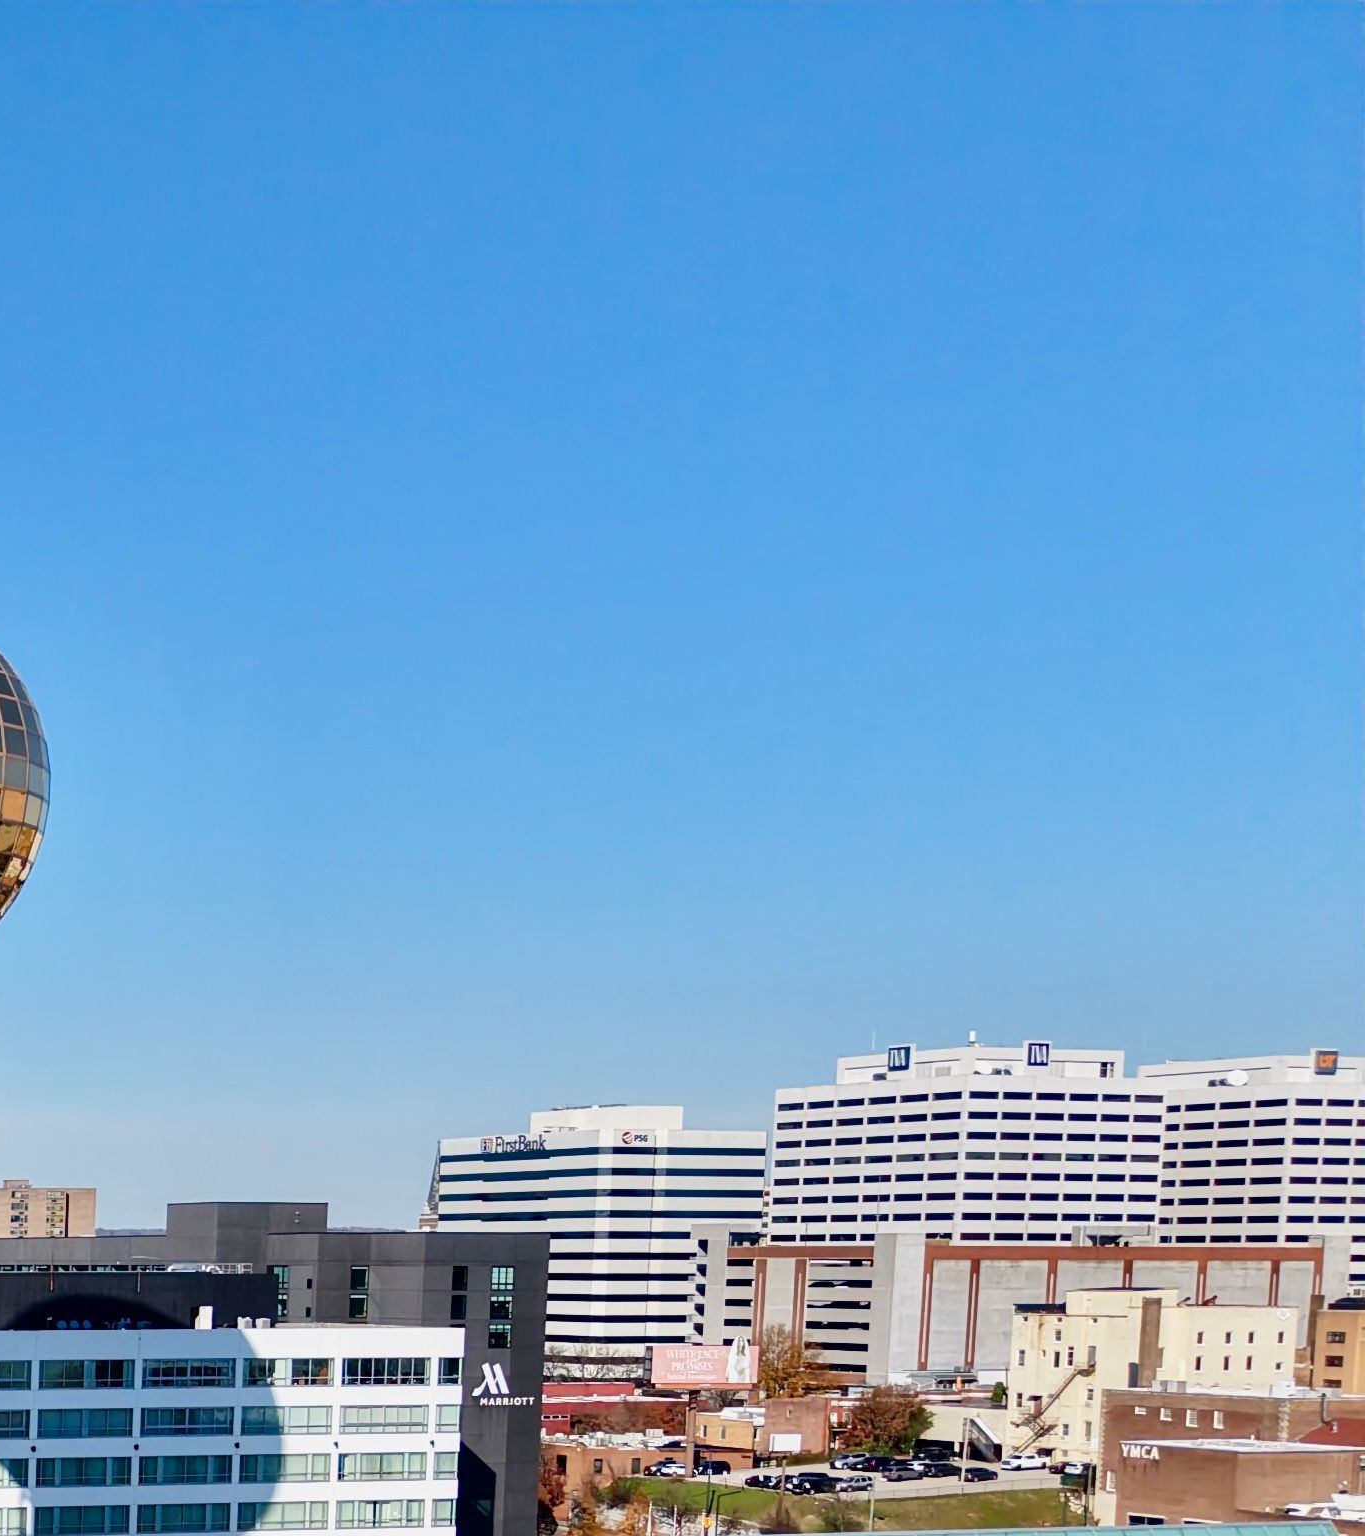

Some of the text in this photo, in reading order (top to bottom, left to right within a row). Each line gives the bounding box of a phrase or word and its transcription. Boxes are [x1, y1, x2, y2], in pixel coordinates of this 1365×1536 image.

[889, 1048, 906, 1068] TVA
[1030, 1045, 1047, 1064] TVA
[495, 1134, 547, 1153] FirstBank
[634, 1134, 648, 1142] PSG
[479, 1397, 535, 1406] MARRIOTT
[1121, 1443, 1160, 1460] YMCA
